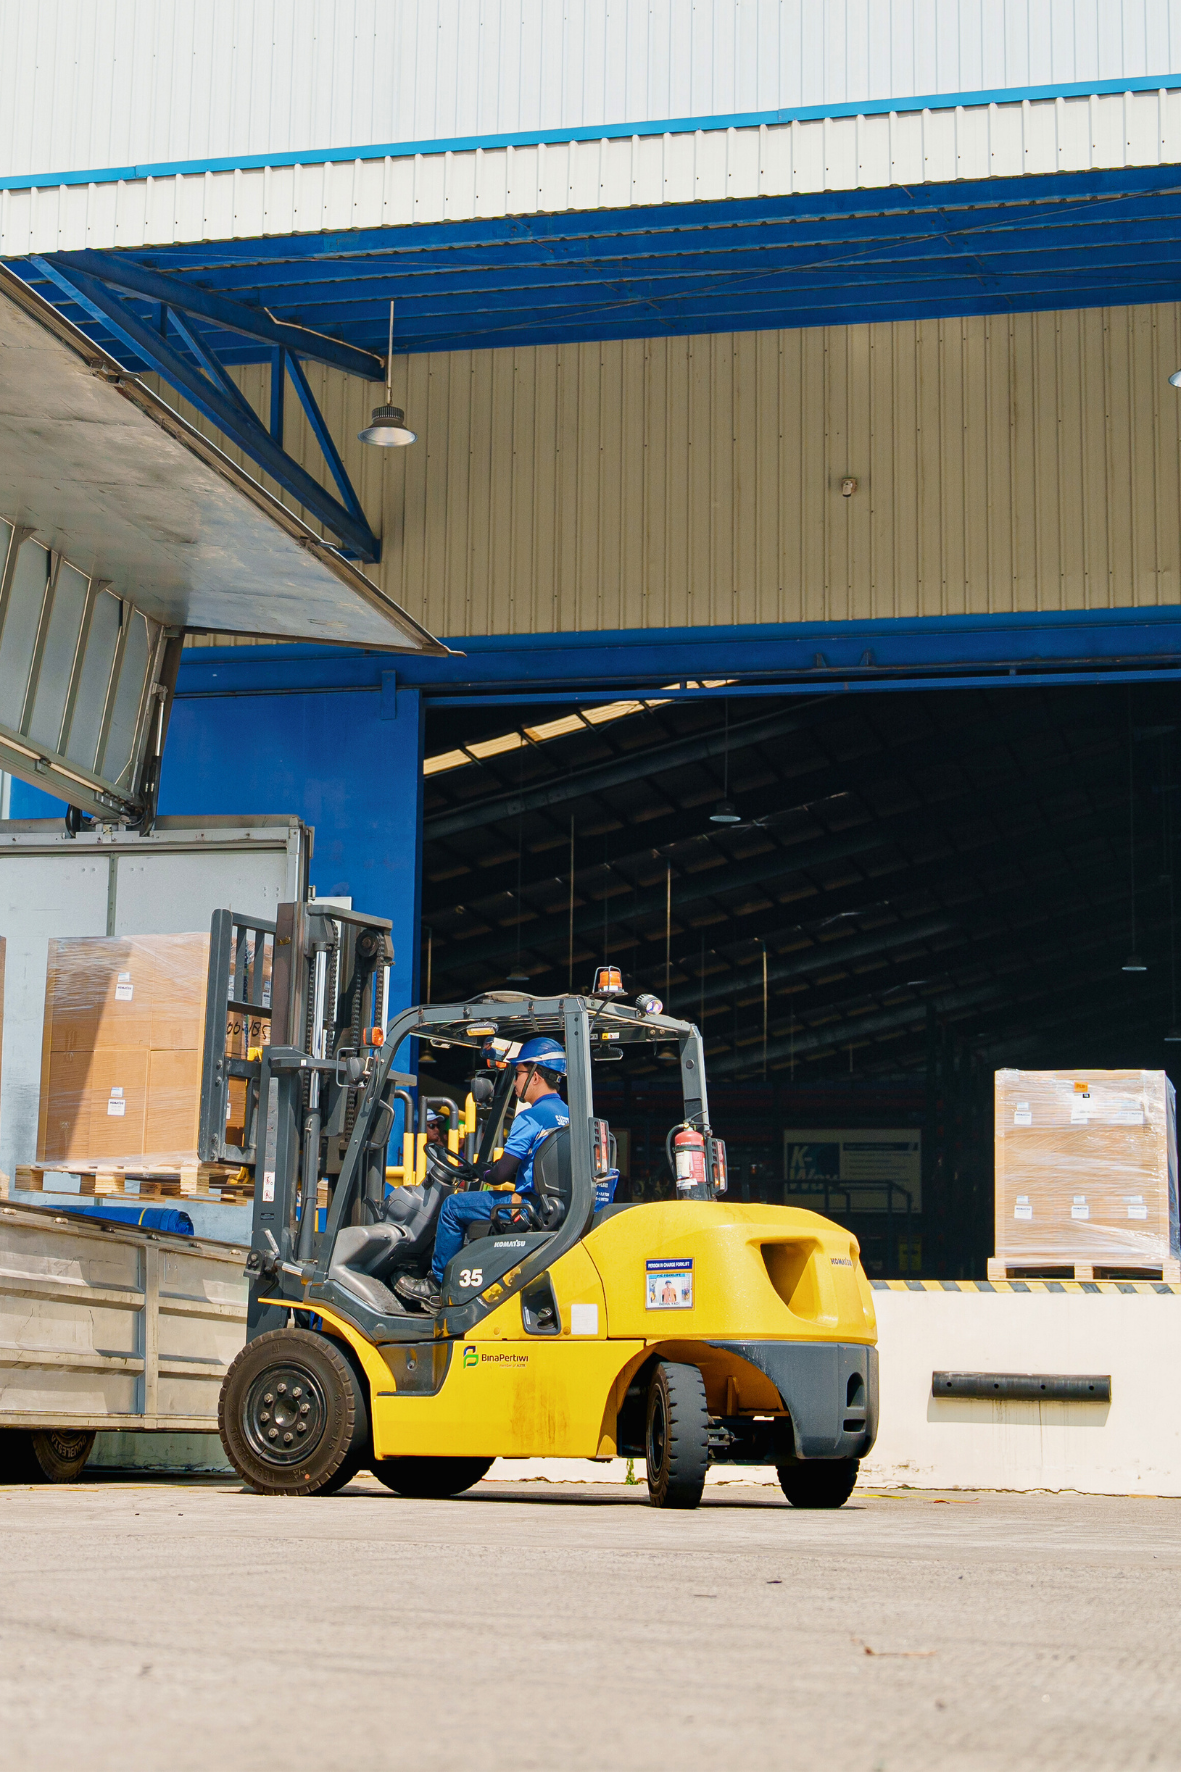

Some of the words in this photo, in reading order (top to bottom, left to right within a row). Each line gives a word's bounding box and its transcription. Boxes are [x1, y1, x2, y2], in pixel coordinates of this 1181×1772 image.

[493, 1239, 526, 1248] KOMATSU
[459, 1268, 483, 1288] 35
[481, 1353, 529, 1362] BinaPertiwi
